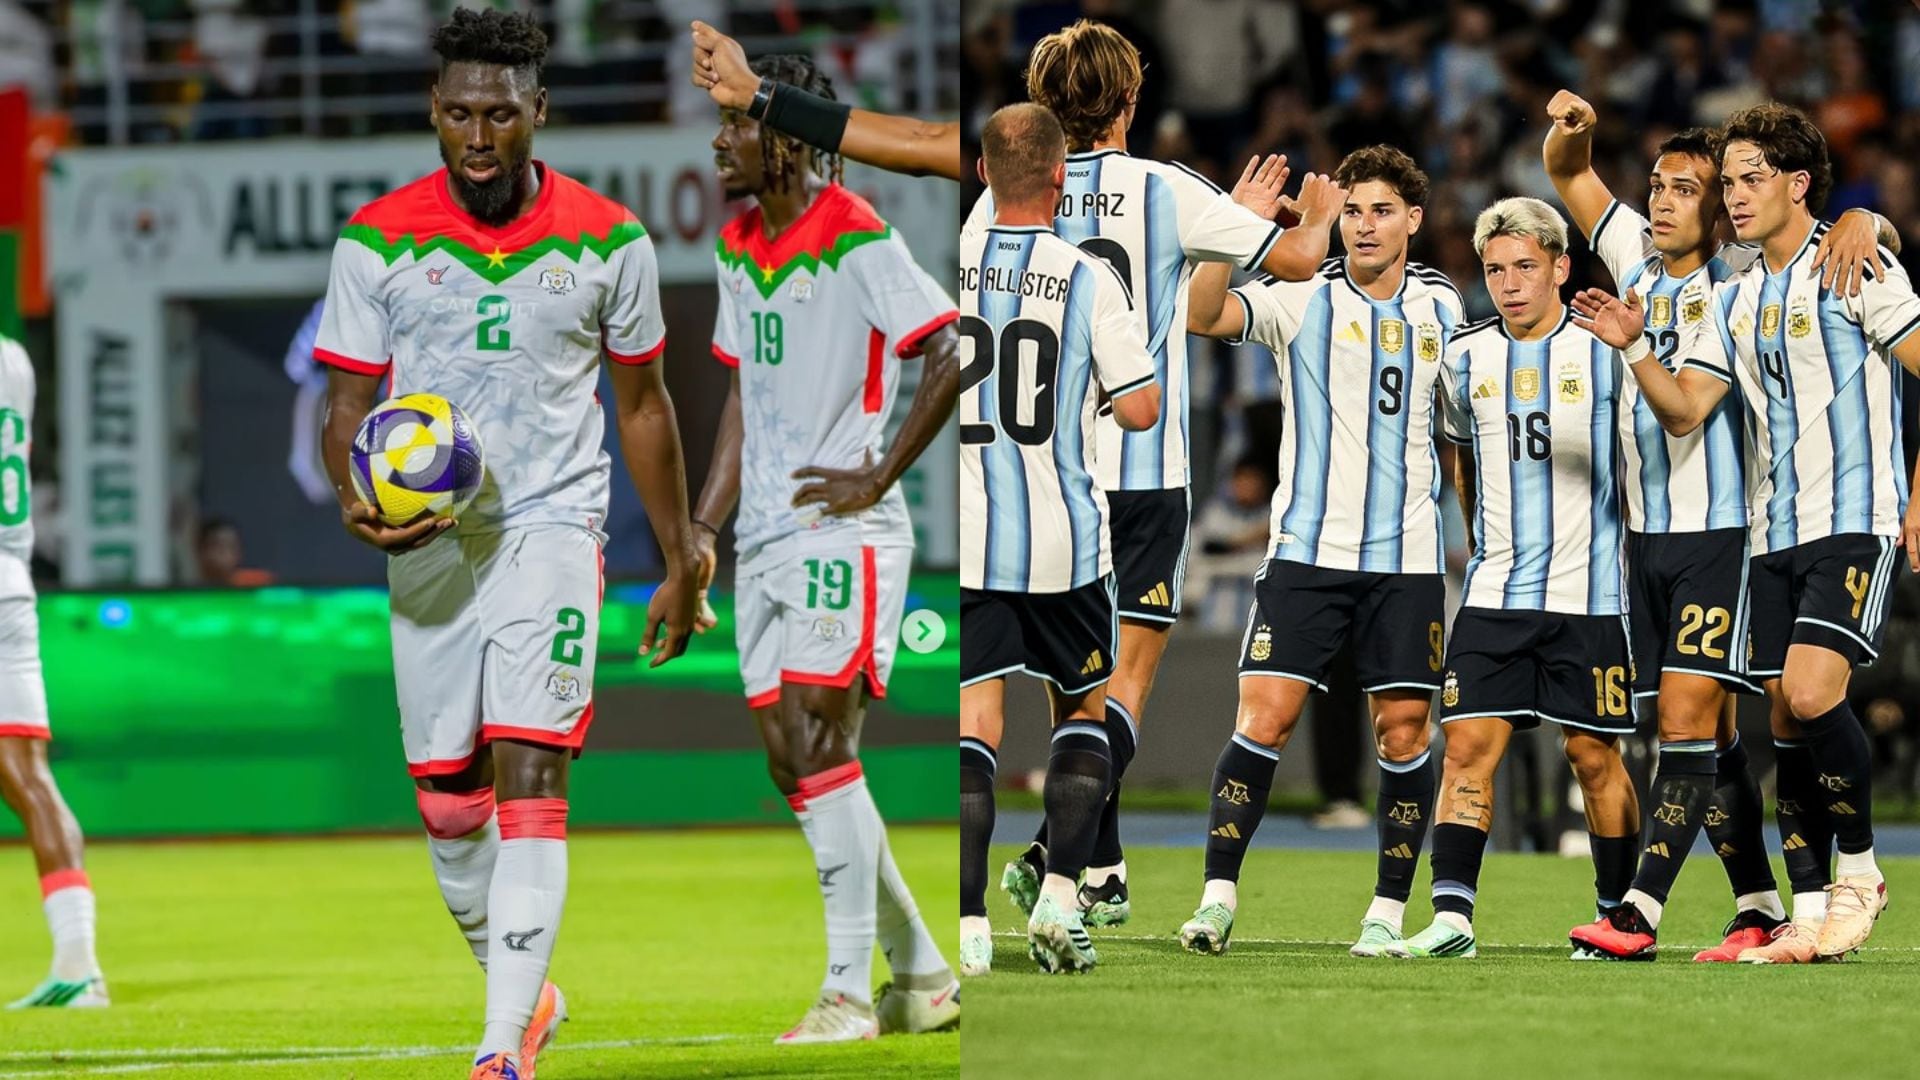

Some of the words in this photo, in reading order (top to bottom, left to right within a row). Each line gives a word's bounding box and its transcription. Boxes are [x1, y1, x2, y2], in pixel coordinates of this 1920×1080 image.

[223, 174, 391, 257] ALLE
[1082, 194, 1125, 217] PAZ
[984, 268, 1069, 303] ALLISTER
[476, 295, 511, 351] 2
[751, 311, 783, 366] 19
[960, 316, 1059, 445] 20
[1378, 366, 1404, 415] 9
[1763, 350, 1787, 399] 4
[1507, 411, 1552, 462] 16
[803, 559, 852, 610] 19
[1845, 566, 1869, 619] 4
[550, 607, 586, 667] 2
[1428, 621, 1443, 672] 9
[1676, 604, 1730, 660] 22
[1592, 666, 1627, 717] 16
[1217, 778, 1250, 805] AFA
[1388, 800, 1421, 825] AFA
[1653, 801, 1687, 826] AFA
